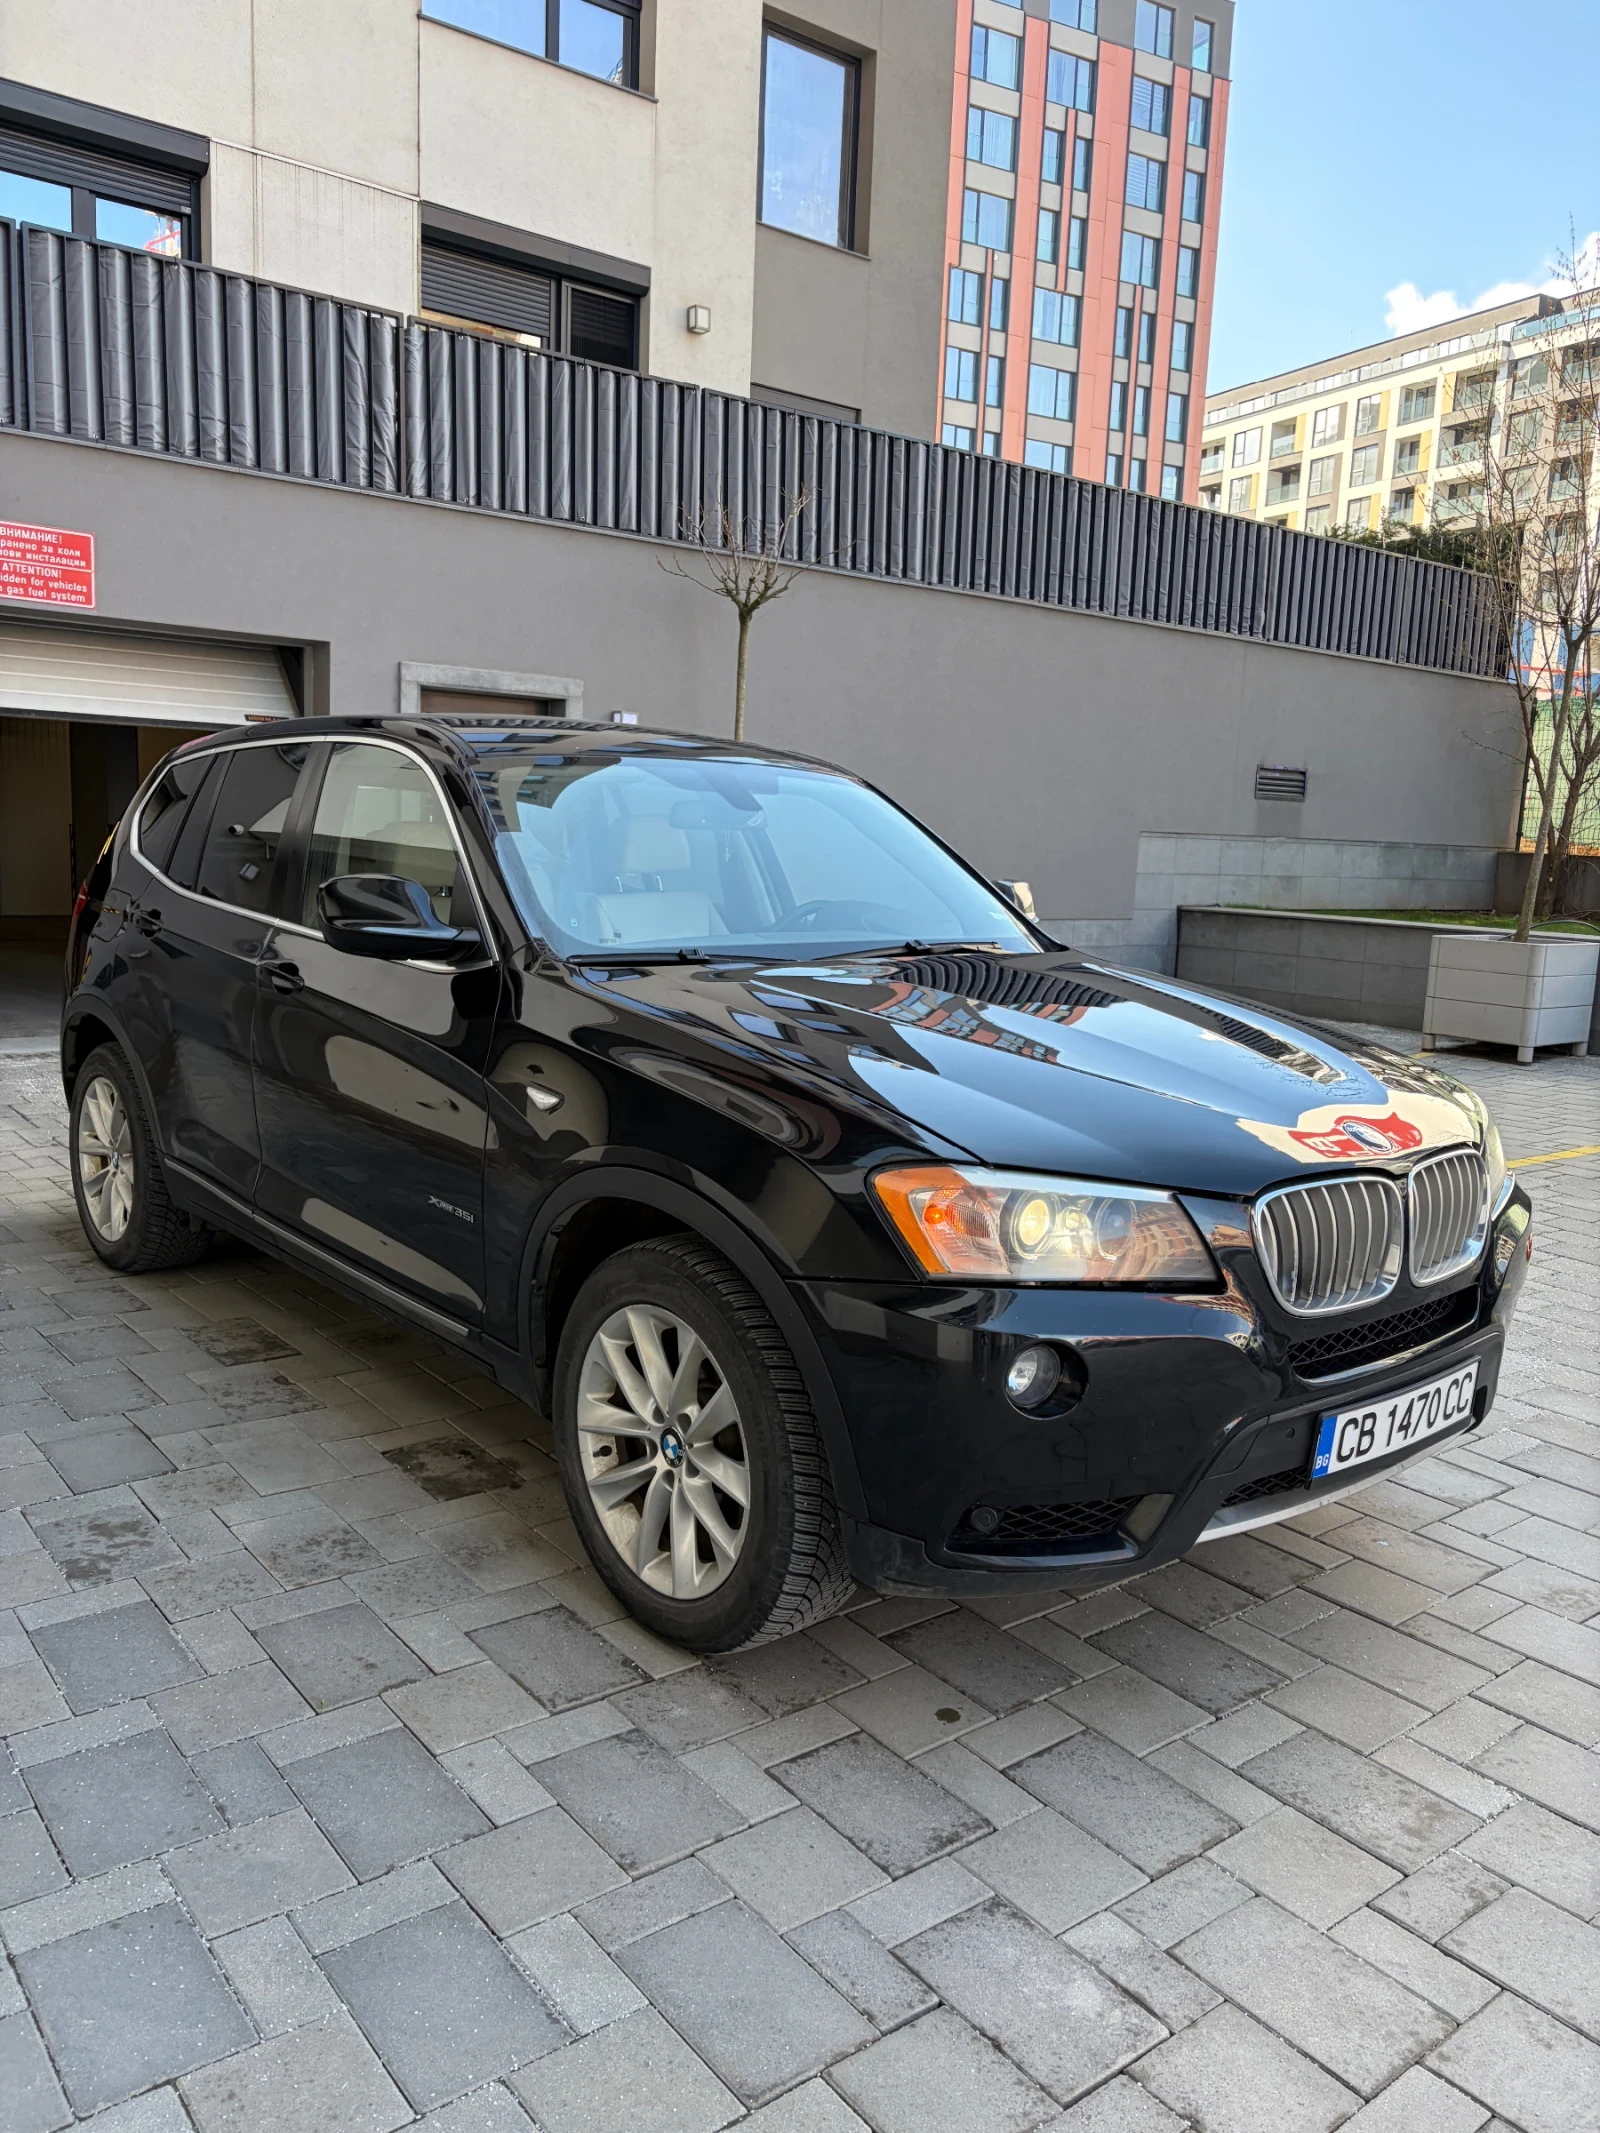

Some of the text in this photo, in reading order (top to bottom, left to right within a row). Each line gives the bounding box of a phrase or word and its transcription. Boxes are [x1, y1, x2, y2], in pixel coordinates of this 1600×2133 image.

[0, 527, 62, 544] ВНИМАНИЕ!
[42, 545, 53, 553] за
[58, 547, 81, 557] коли
[26, 552, 86, 567] инсталации
[2, 562, 62, 578] ATTENTION!
[31, 577, 44, 587] for
[48, 580, 87, 592] vehicles
[7, 586, 24, 595] gas
[28, 587, 46, 597] fuel
[51, 591, 85, 602] system
[1336, 1371, 1473, 1463] CB 1470 CC
[1315, 1453, 1330, 1469] BG
